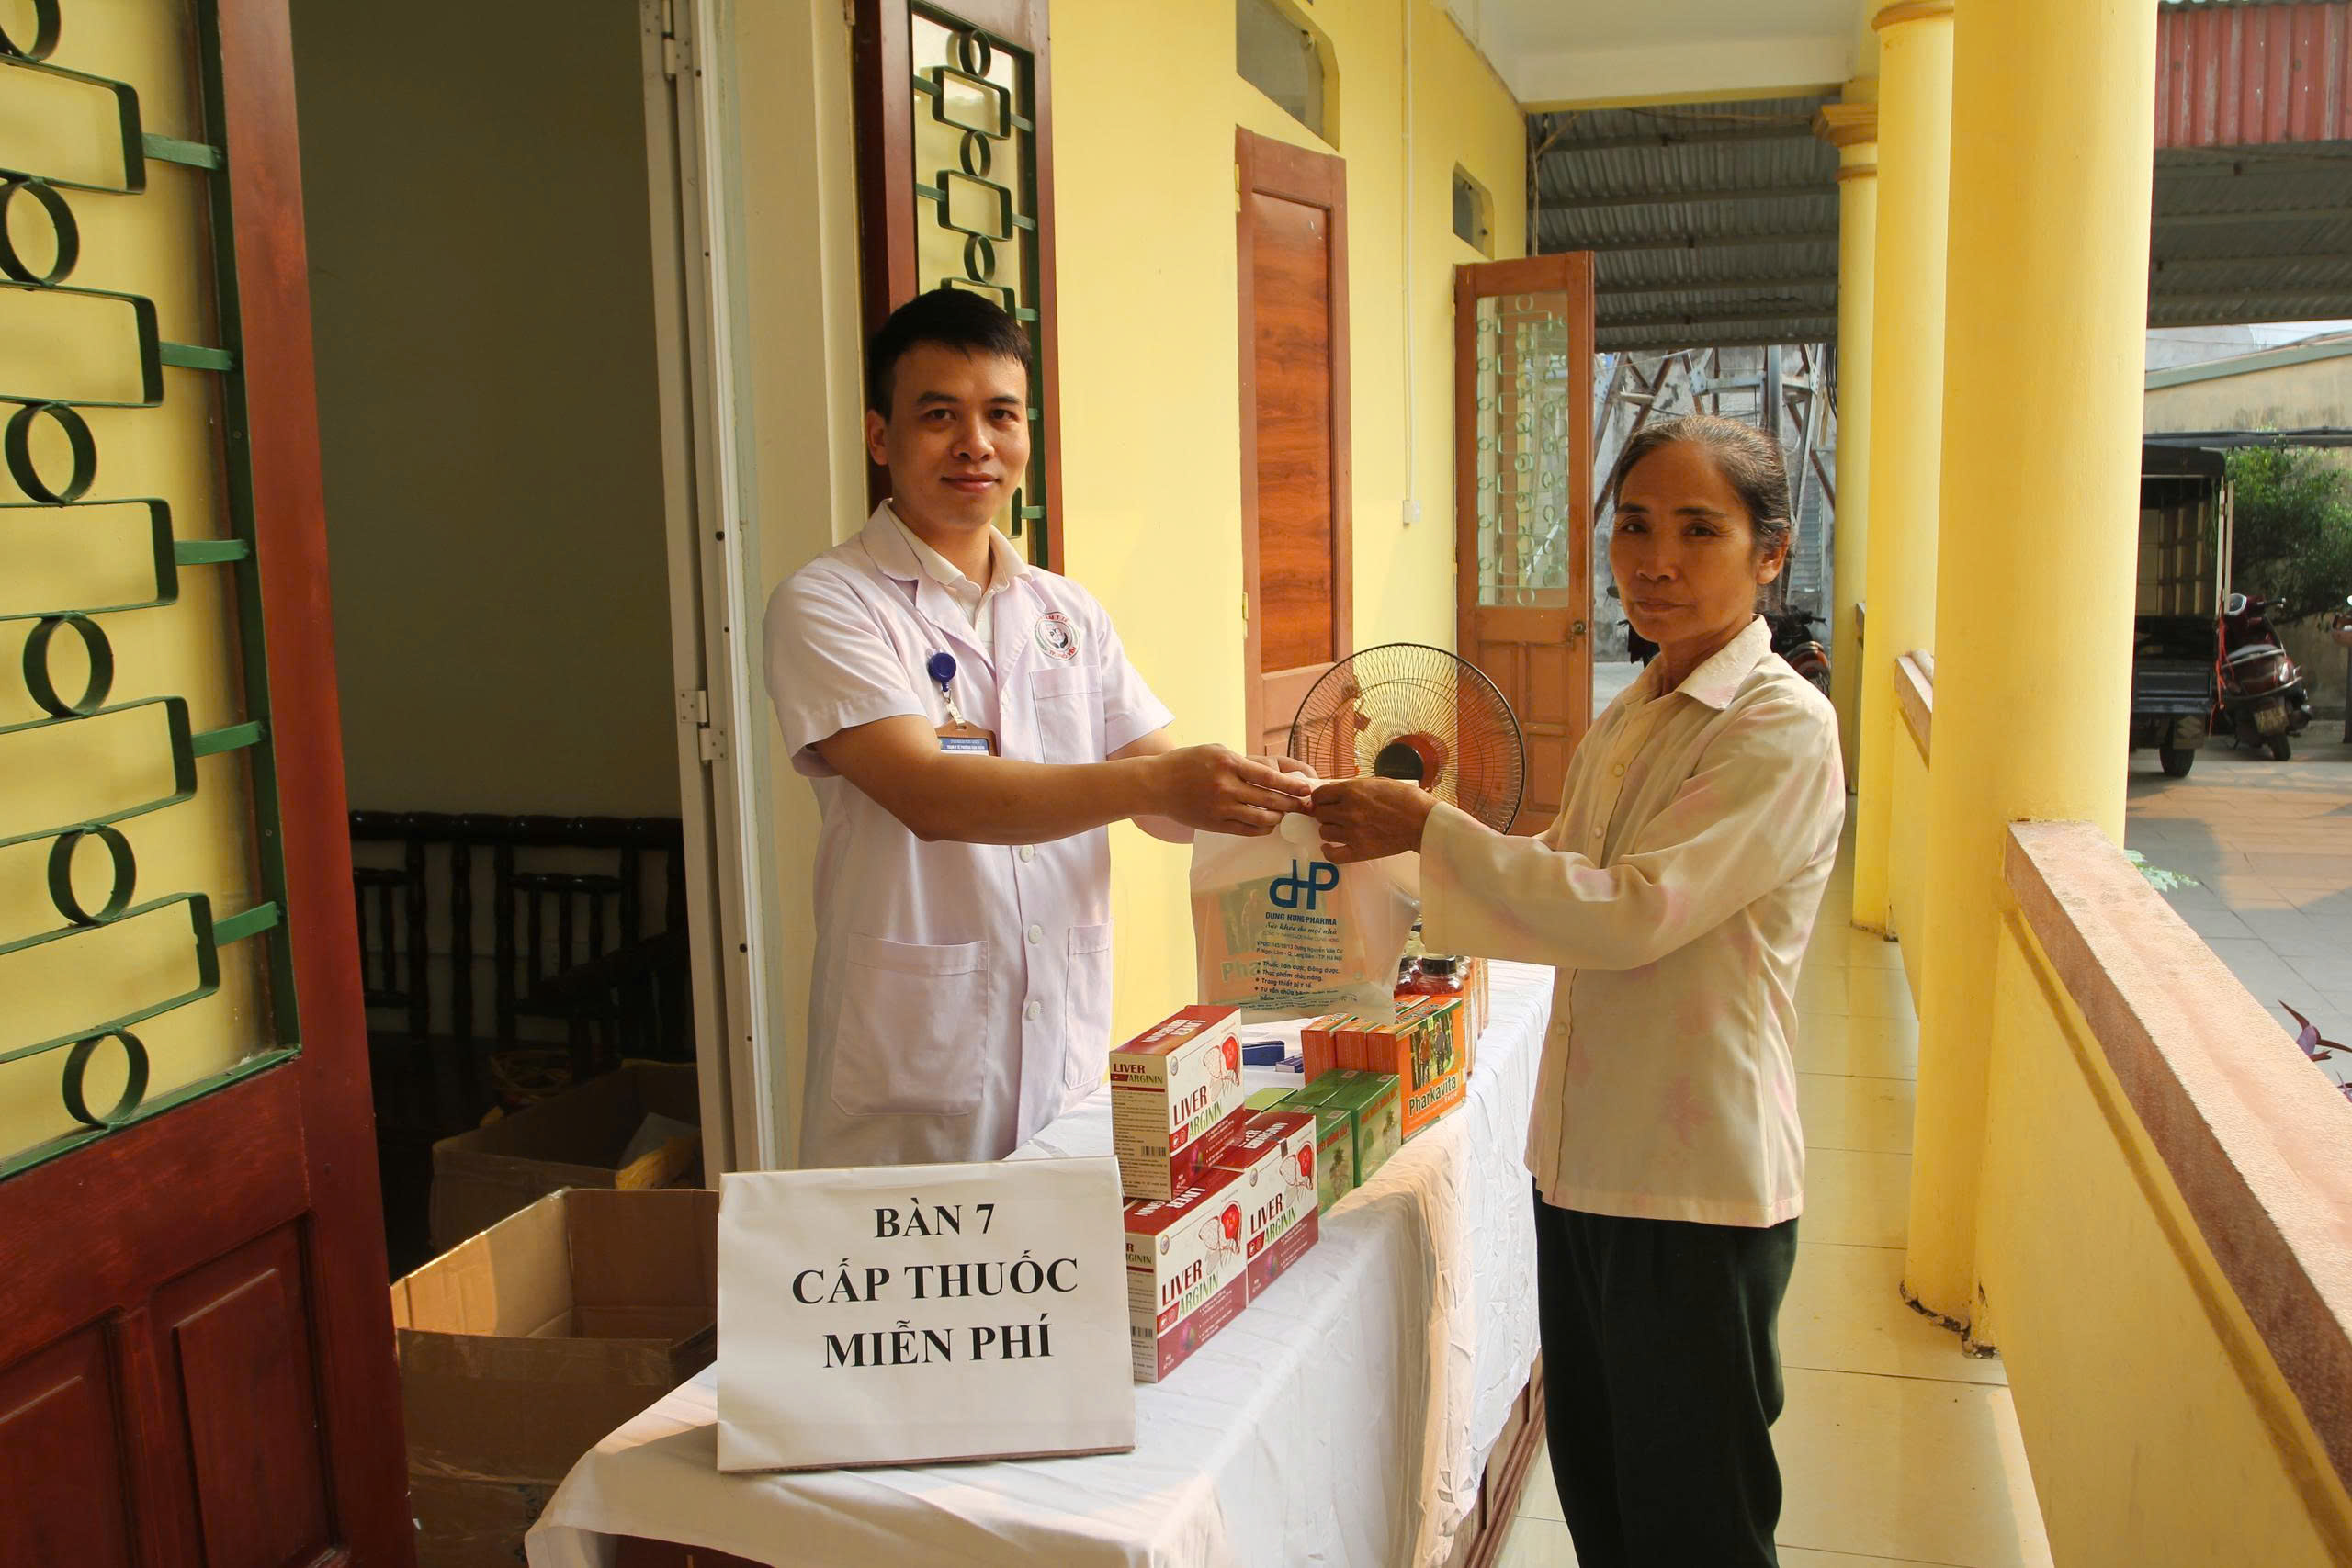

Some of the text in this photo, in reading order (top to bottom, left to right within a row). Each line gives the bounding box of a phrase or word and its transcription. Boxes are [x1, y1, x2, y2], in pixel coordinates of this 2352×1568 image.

[1306, 916, 1337, 926] PHARMA
[1113, 1063, 1146, 1074] LIVER
[1128, 1074, 1163, 1085] ARGININ
[1173, 1084, 1208, 1127] LIVER
[1409, 1076, 1456, 1117] Pharkavita
[1189, 1100, 1223, 1139] ARGININ
[873, 1197, 996, 1238] BÀN 7
[1165, 1187, 1206, 1209] LIVER
[1250, 1192, 1283, 1235] LIVER
[1264, 1205, 1297, 1246] ARGININ
[792, 1249, 1079, 1304] CẤP THUỐC
[1126, 1252, 1153, 1265] GININ
[1162, 1258, 1203, 1307] LIVER
[1179, 1271, 1220, 1319] ARGININ
[822, 1313, 1055, 1369] MIỄN PHÍ
